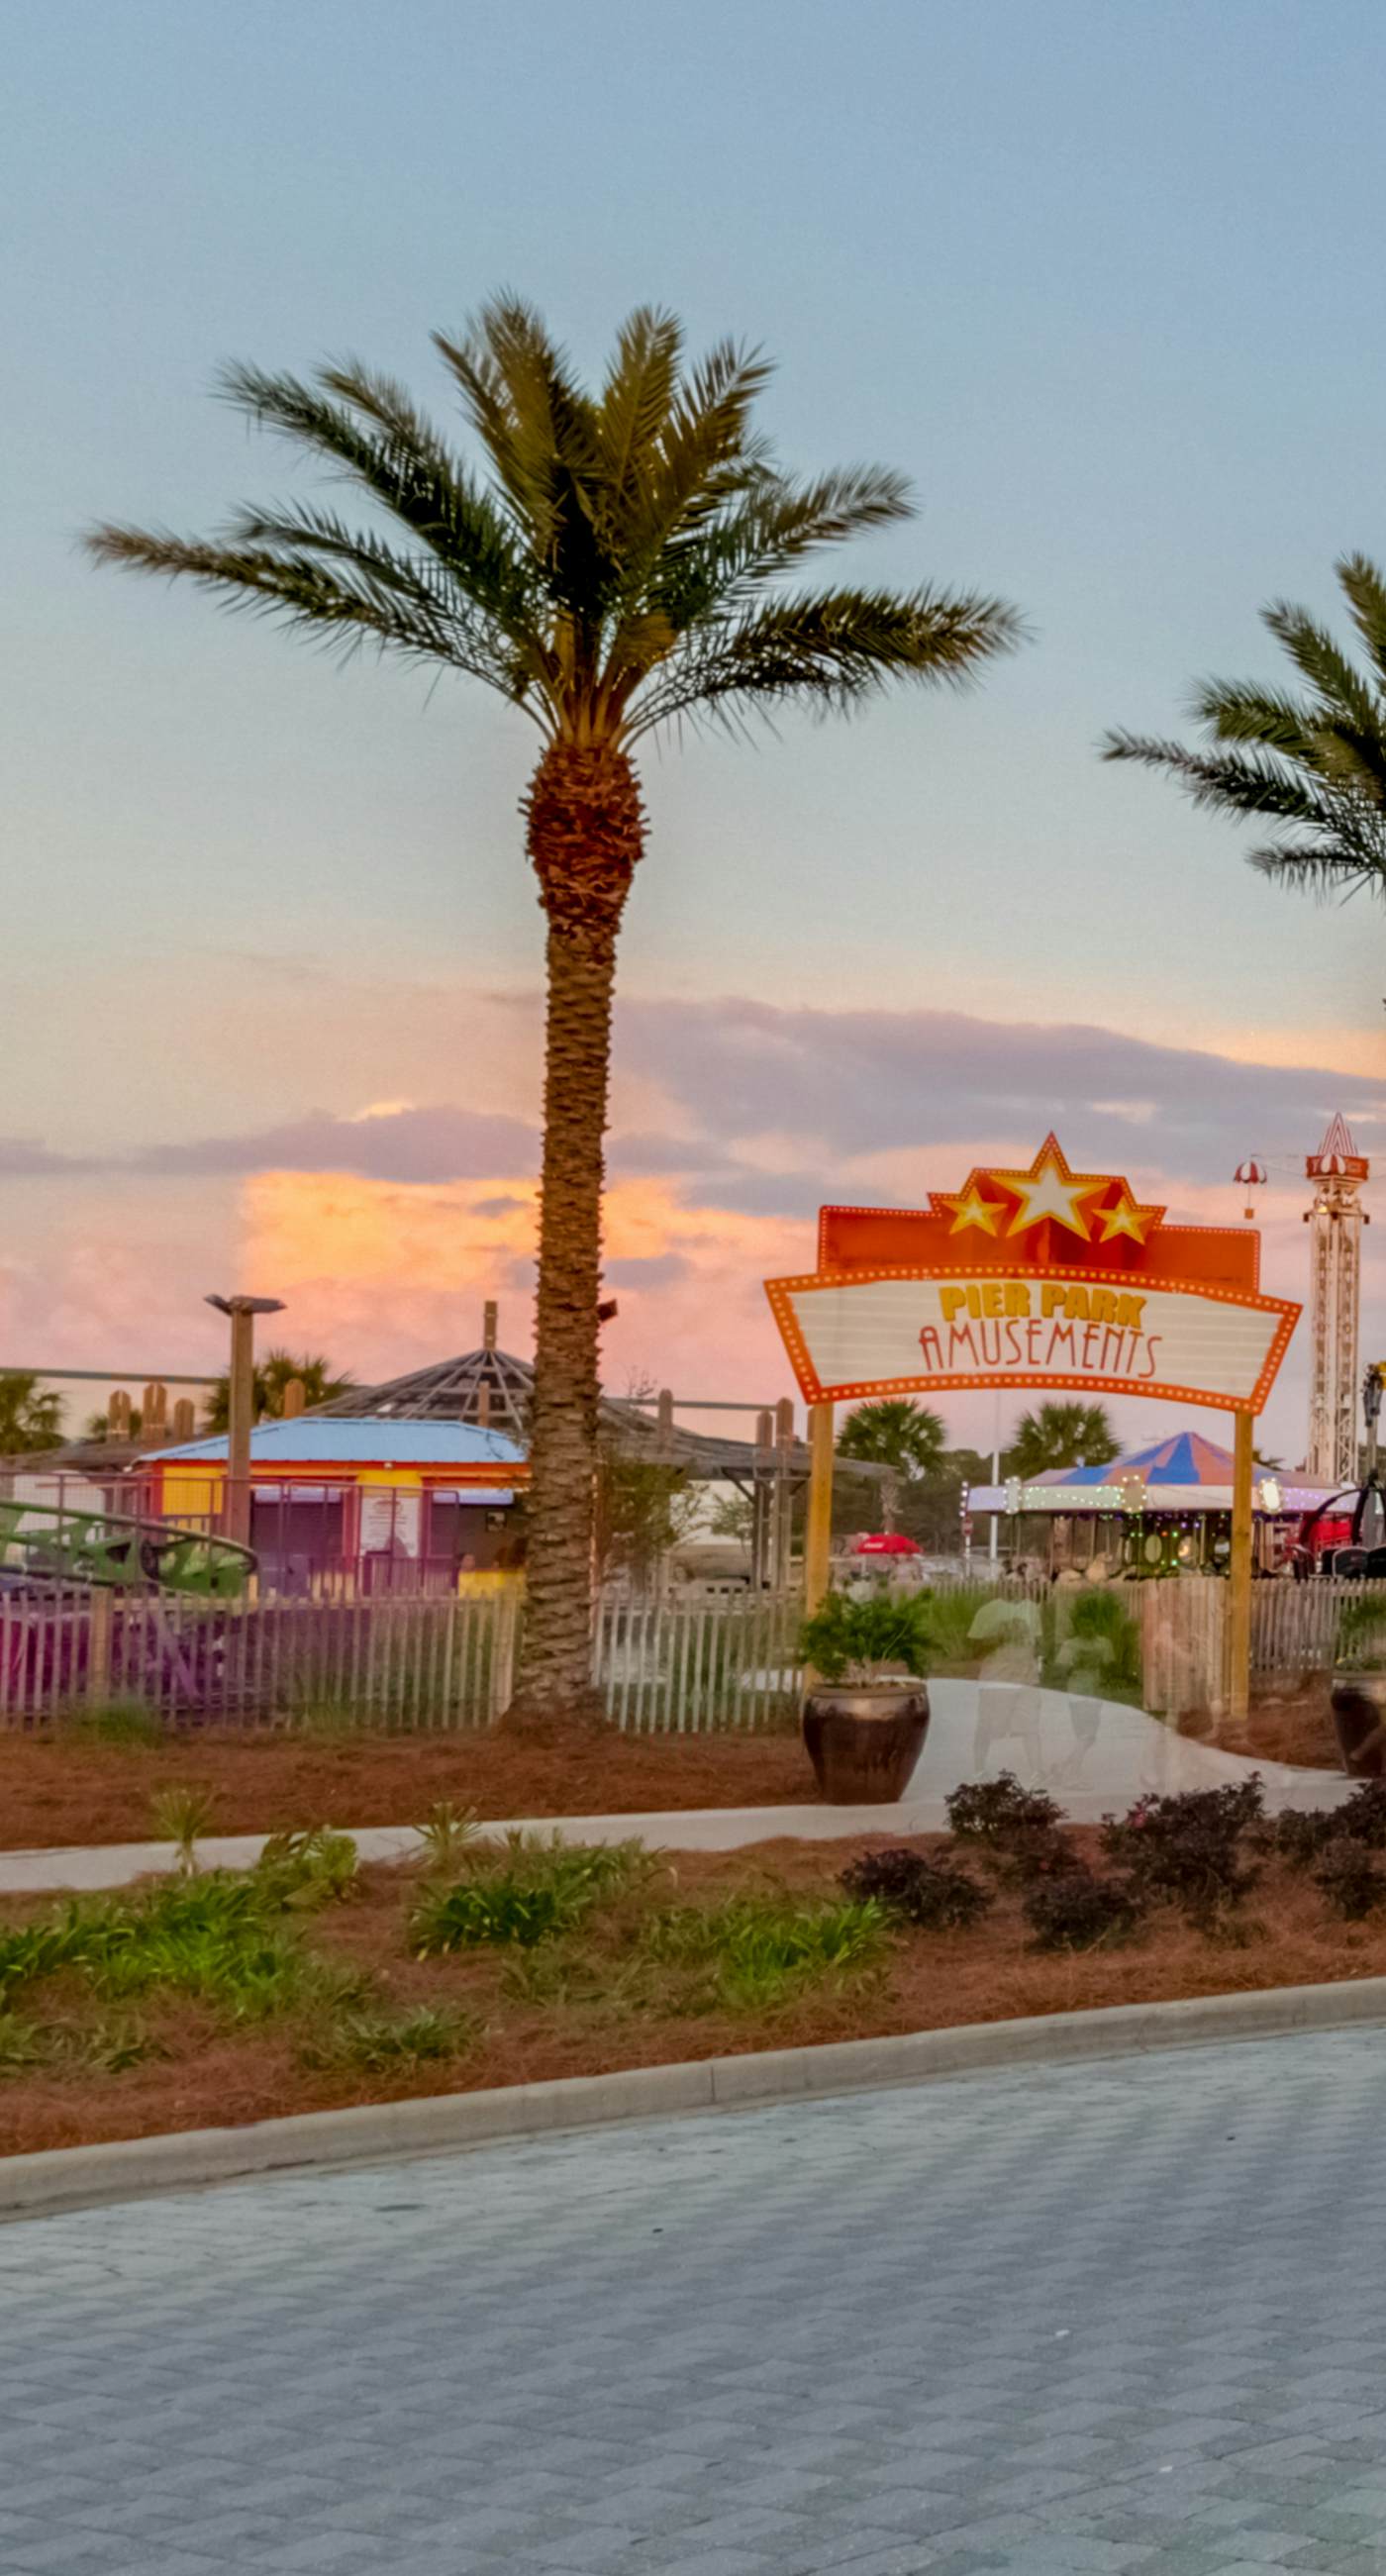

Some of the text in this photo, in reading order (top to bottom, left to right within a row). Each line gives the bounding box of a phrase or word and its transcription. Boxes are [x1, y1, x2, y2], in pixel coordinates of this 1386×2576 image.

[939, 1283, 1147, 1329] PIER PARK
[919, 1320, 1163, 1379] AMUSEMENTS
